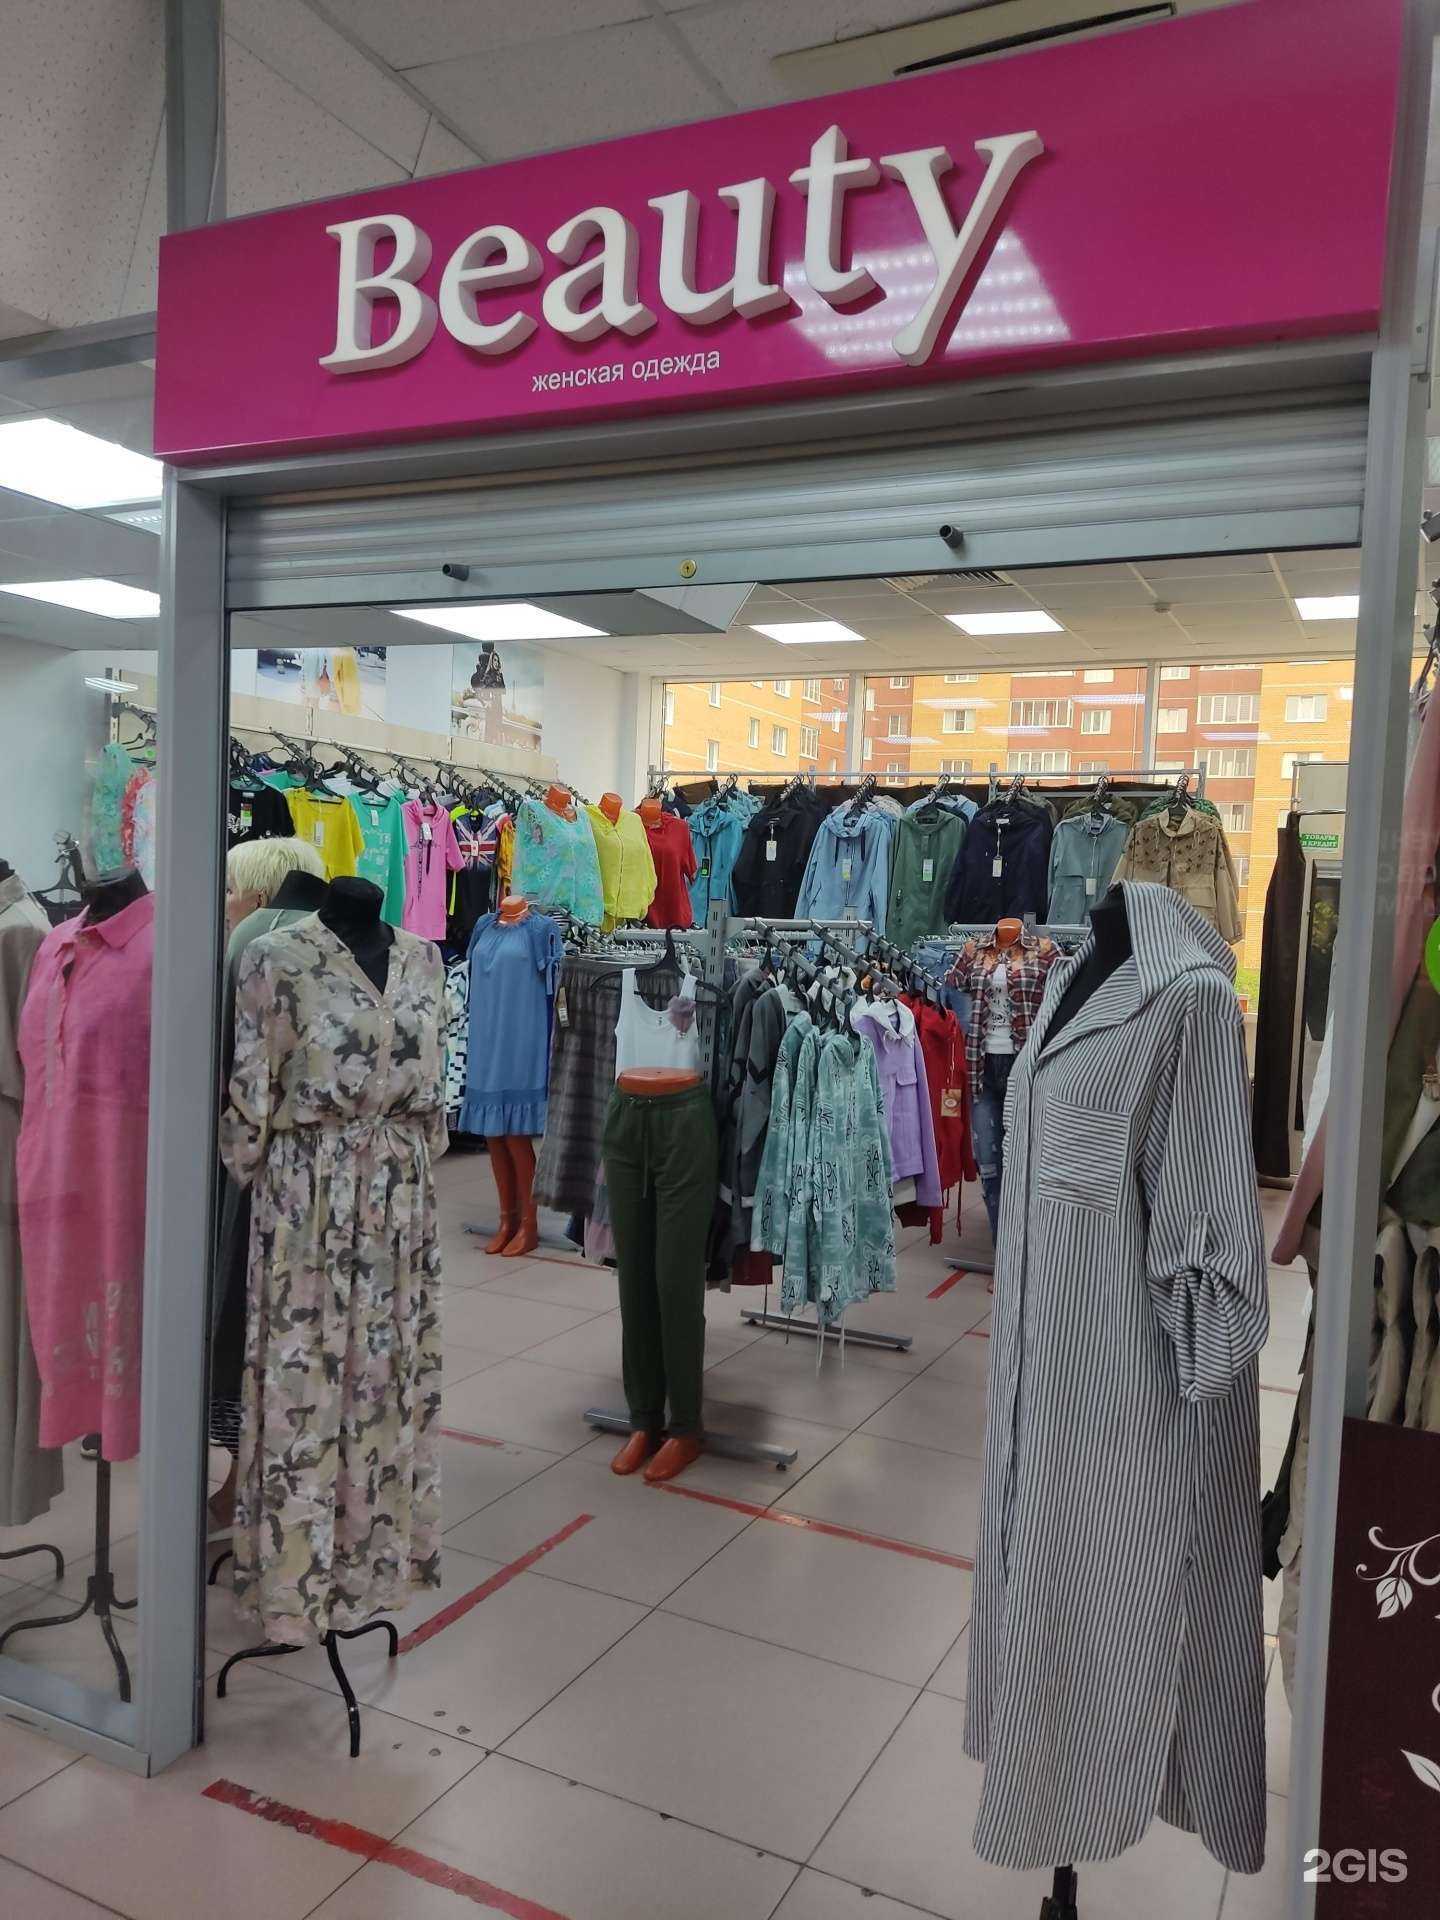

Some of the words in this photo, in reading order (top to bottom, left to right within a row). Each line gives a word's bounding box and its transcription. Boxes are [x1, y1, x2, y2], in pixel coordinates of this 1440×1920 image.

[319, 124, 1045, 375] Beauty
[531, 363, 625, 393] женская
[631, 350, 721, 382] одежда
